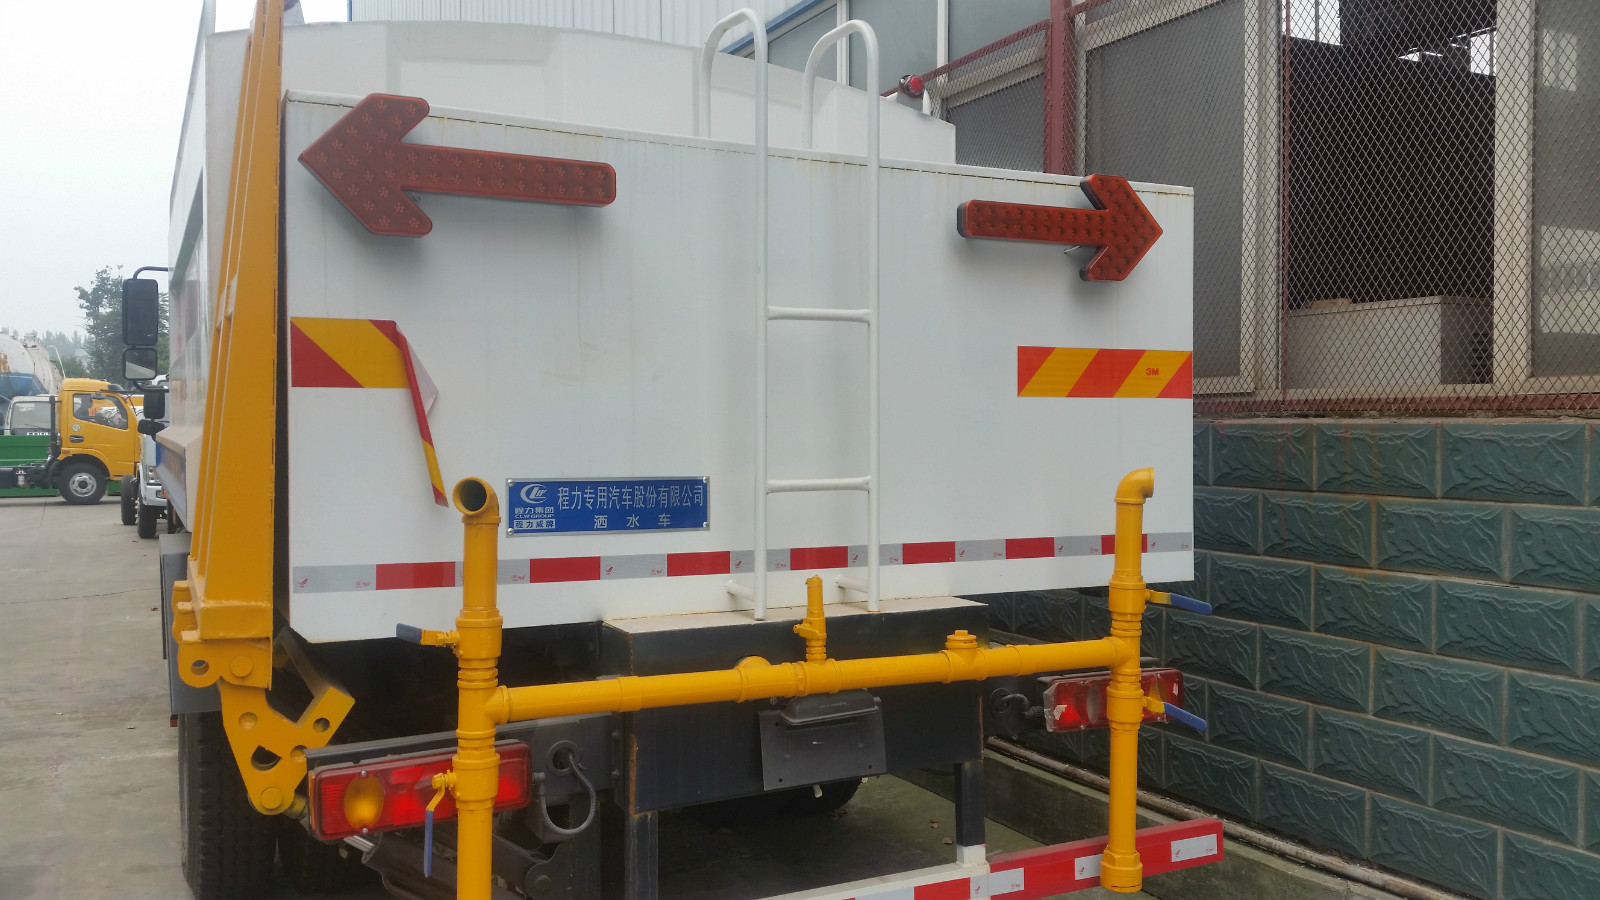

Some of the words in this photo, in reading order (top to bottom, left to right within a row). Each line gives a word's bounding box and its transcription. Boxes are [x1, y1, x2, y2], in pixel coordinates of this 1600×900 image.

[1146, 368, 1159, 376] 3M
[557, 485, 704, 510] 程力专用汽车股份有限公司
[514, 506, 555, 514] 程力集团
